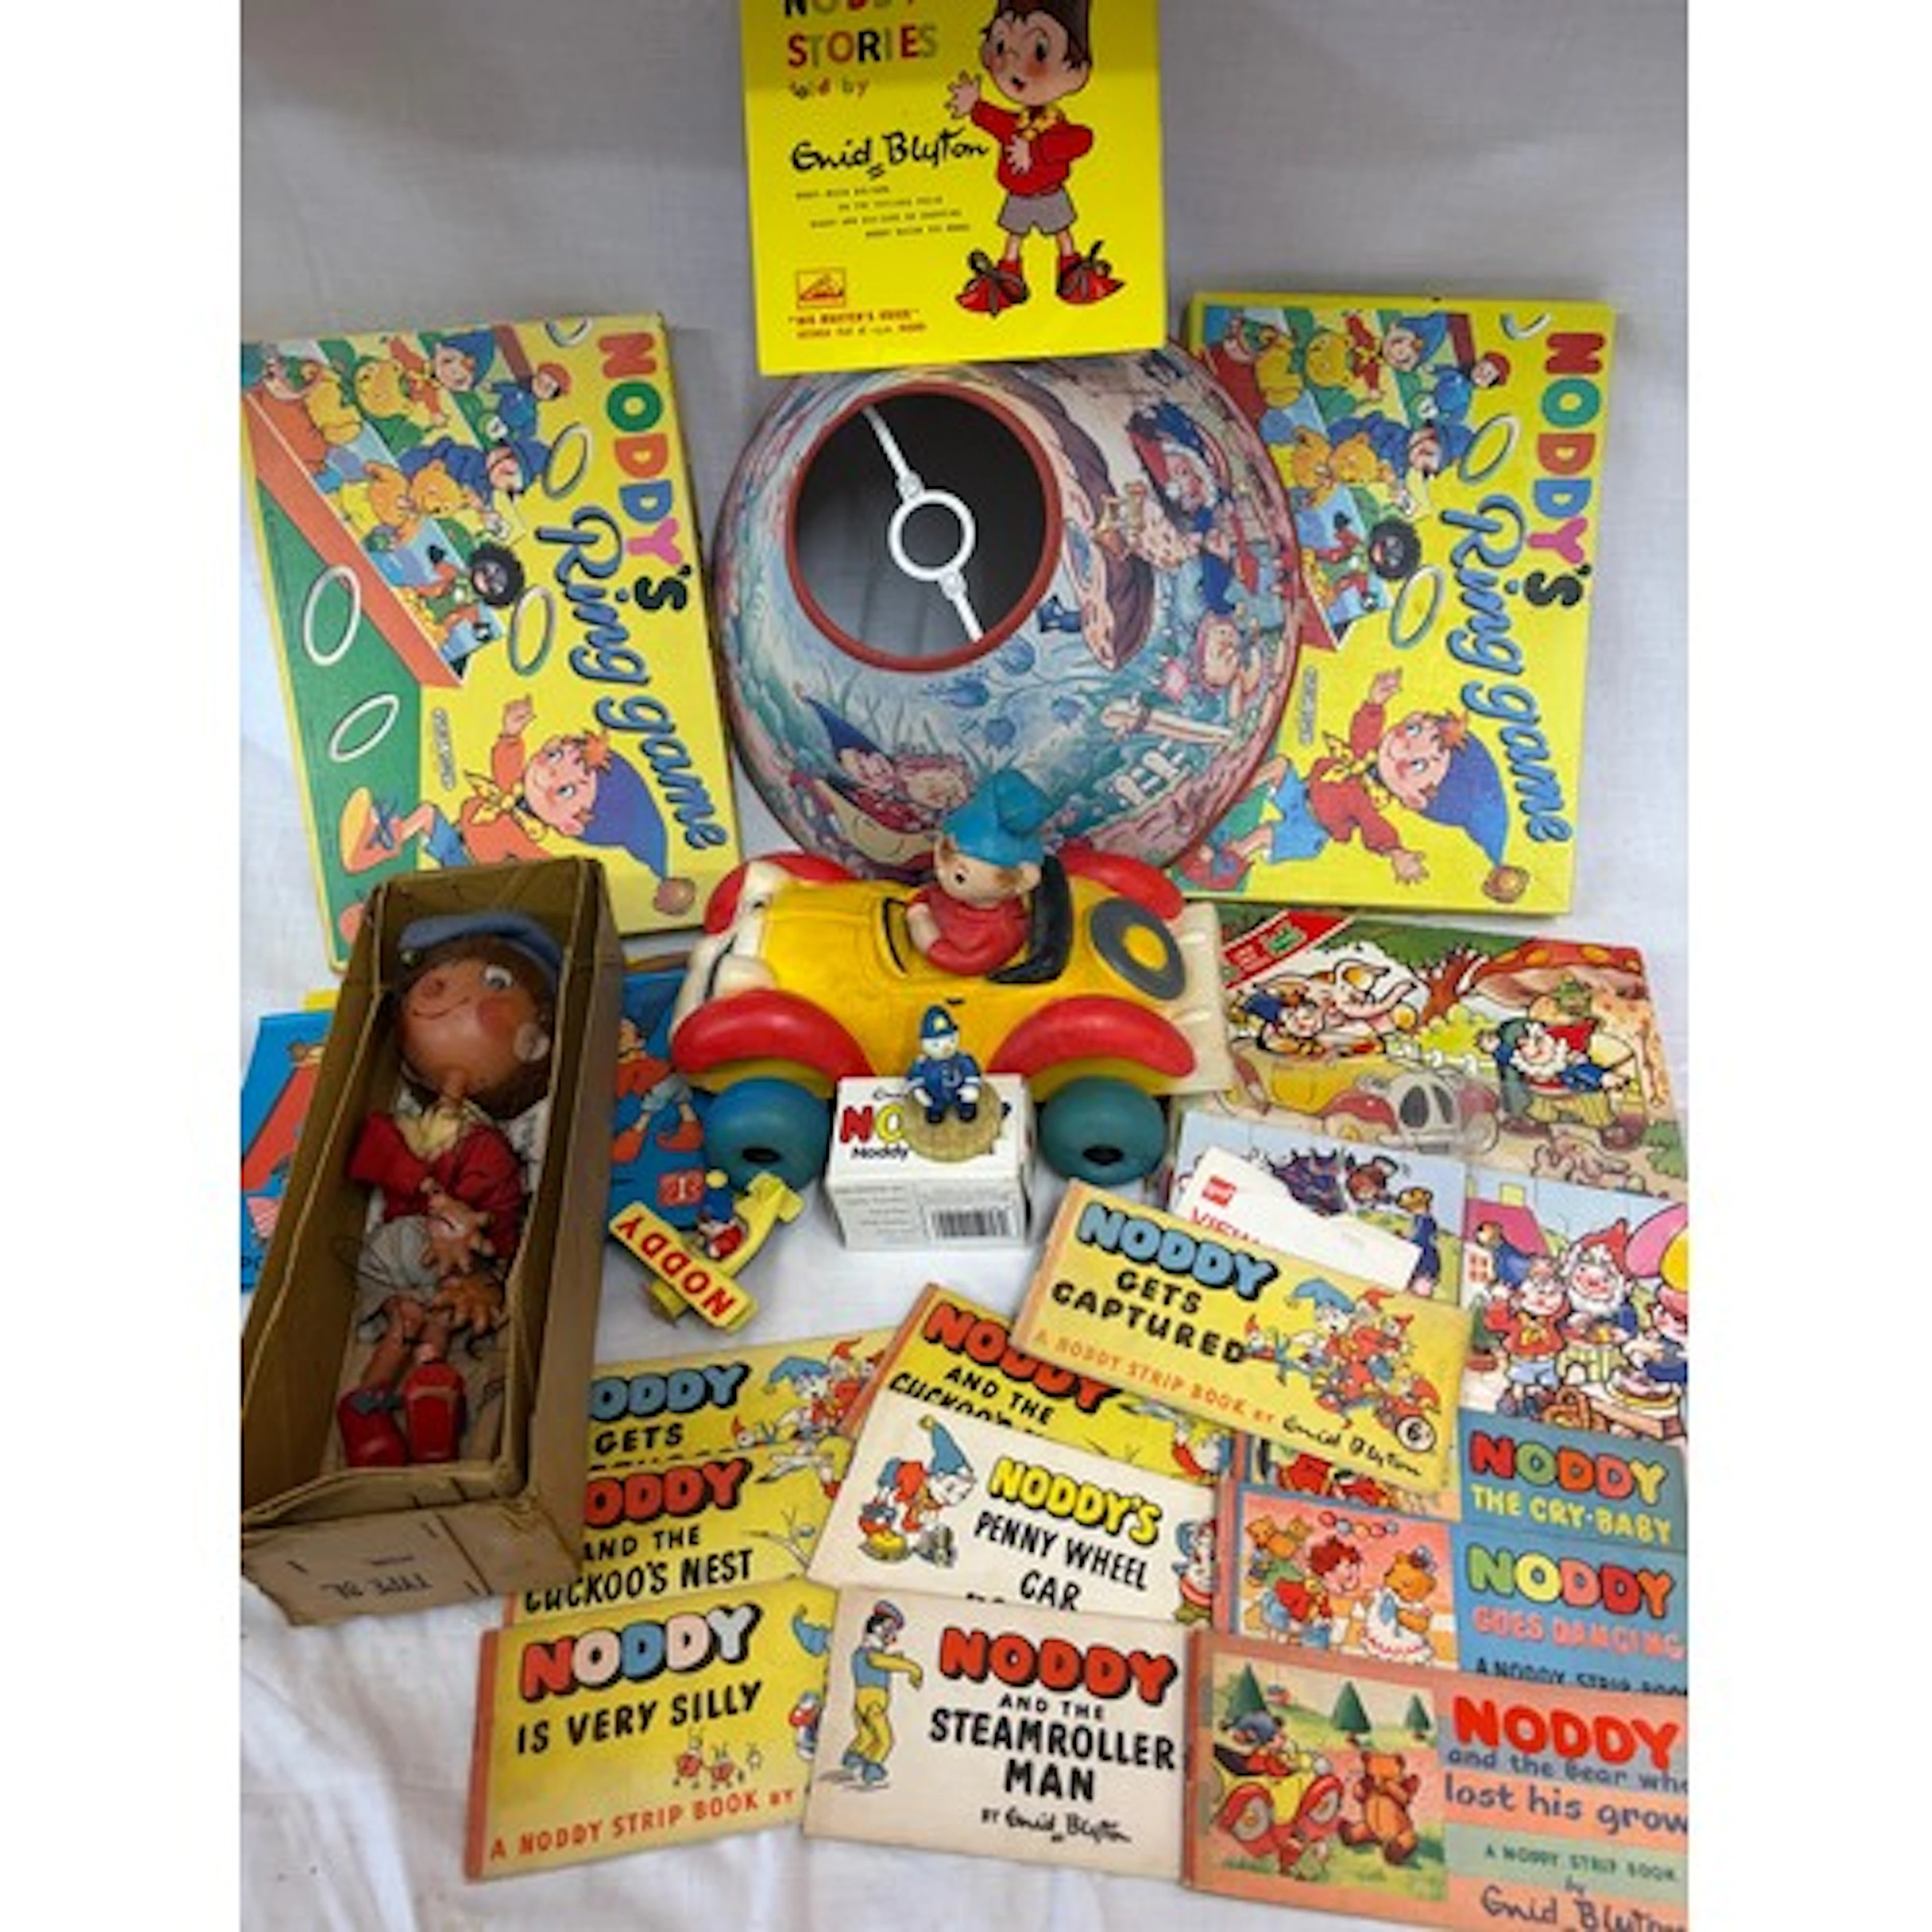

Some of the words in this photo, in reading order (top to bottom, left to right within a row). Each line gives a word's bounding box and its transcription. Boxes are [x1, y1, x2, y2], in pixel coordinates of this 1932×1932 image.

[788, 22, 937, 68] STORIES
[792, 136, 871, 171] Enid
[881, 126, 990, 168] Blyton
[599, 333, 694, 612] NODDY'S
[1523, 332, 1606, 608] NODDY'S
[1439, 493, 1526, 675] Ring
[537, 506, 651, 685] Ring
[596, 695, 728, 850] game
[1463, 681, 1573, 844] game
[616, 1215, 734, 1317] NODDY
[1076, 1199, 1279, 1301] NODDY
[1051, 1278, 1248, 1365] CAPTURED
[1115, 1270, 1202, 1315] GETS
[590, 1362, 751, 1421] ODDY
[944, 1367, 999, 1398] AND
[1009, 1392, 1055, 1425] THE
[1035, 1329, 1048, 1345] A
[1057, 1336, 1121, 1370] NODDY
[1126, 1360, 1185, 1391] STRIP
[1190, 1381, 1248, 1415] BOOK
[1283, 1416, 1341, 1447] Enid
[595, 1423, 684, 1455] GETS
[1469, 1430, 1668, 1506] NODDY
[584, 1458, 753, 1528] ODDY
[987, 1457, 1163, 1548] NODDY'S
[1470, 1484, 1521, 1516] THE
[653, 1525, 700, 1550] THE
[681, 1549, 754, 1588] NEST
[974, 1511, 1057, 1559] PENNY
[1065, 1537, 1149, 1591] WHEEL
[1019, 1569, 1082, 1611] CAR
[1466, 1543, 1675, 1619] NODDY
[520, 1600, 764, 1702] NODDY
[1473, 1606, 1544, 1640] GOES
[1551, 1617, 1685, 1660] DANCING
[939, 1627, 1178, 1706] NODDY
[1476, 1657, 1488, 1675] A
[1494, 1661, 1565, 1684] NODDY
[517, 1721, 548, 1755] IS
[567, 1699, 658, 1746] VERY
[670, 1680, 763, 1728] SILLY
[997, 1693, 1048, 1712] AND
[1061, 1700, 1104, 1721] THE
[1453, 1696, 1679, 1771] NODDY
[929, 1708, 1176, 1771] STEAMROLLER
[1447, 1749, 1497, 1769] and
[1510, 1753, 1556, 1780] the
[1005, 1758, 1094, 1801] MAN
[1444, 1773, 1517, 1809] lost
[1528, 1784, 1582, 1821] his
[491, 1838, 507, 1861] A
[518, 1819, 602, 1855] NODDY
[612, 1805, 684, 1839] STRIP
[693, 1790, 759, 1821] BOOK
[769, 1789, 796, 1806] BY
[982, 1808, 998, 1825] BY
[1006, 1806, 1056, 1831] Enid
[1064, 1815, 1132, 1844] Blyton
[1485, 1844, 1495, 1859] A
[1502, 1845, 1558, 1867] NODDY
[1568, 1854, 1616, 1875] STRIP
[1627, 1862, 1676, 1883] BOOK
[1481, 1884, 1558, 1924] Enid
